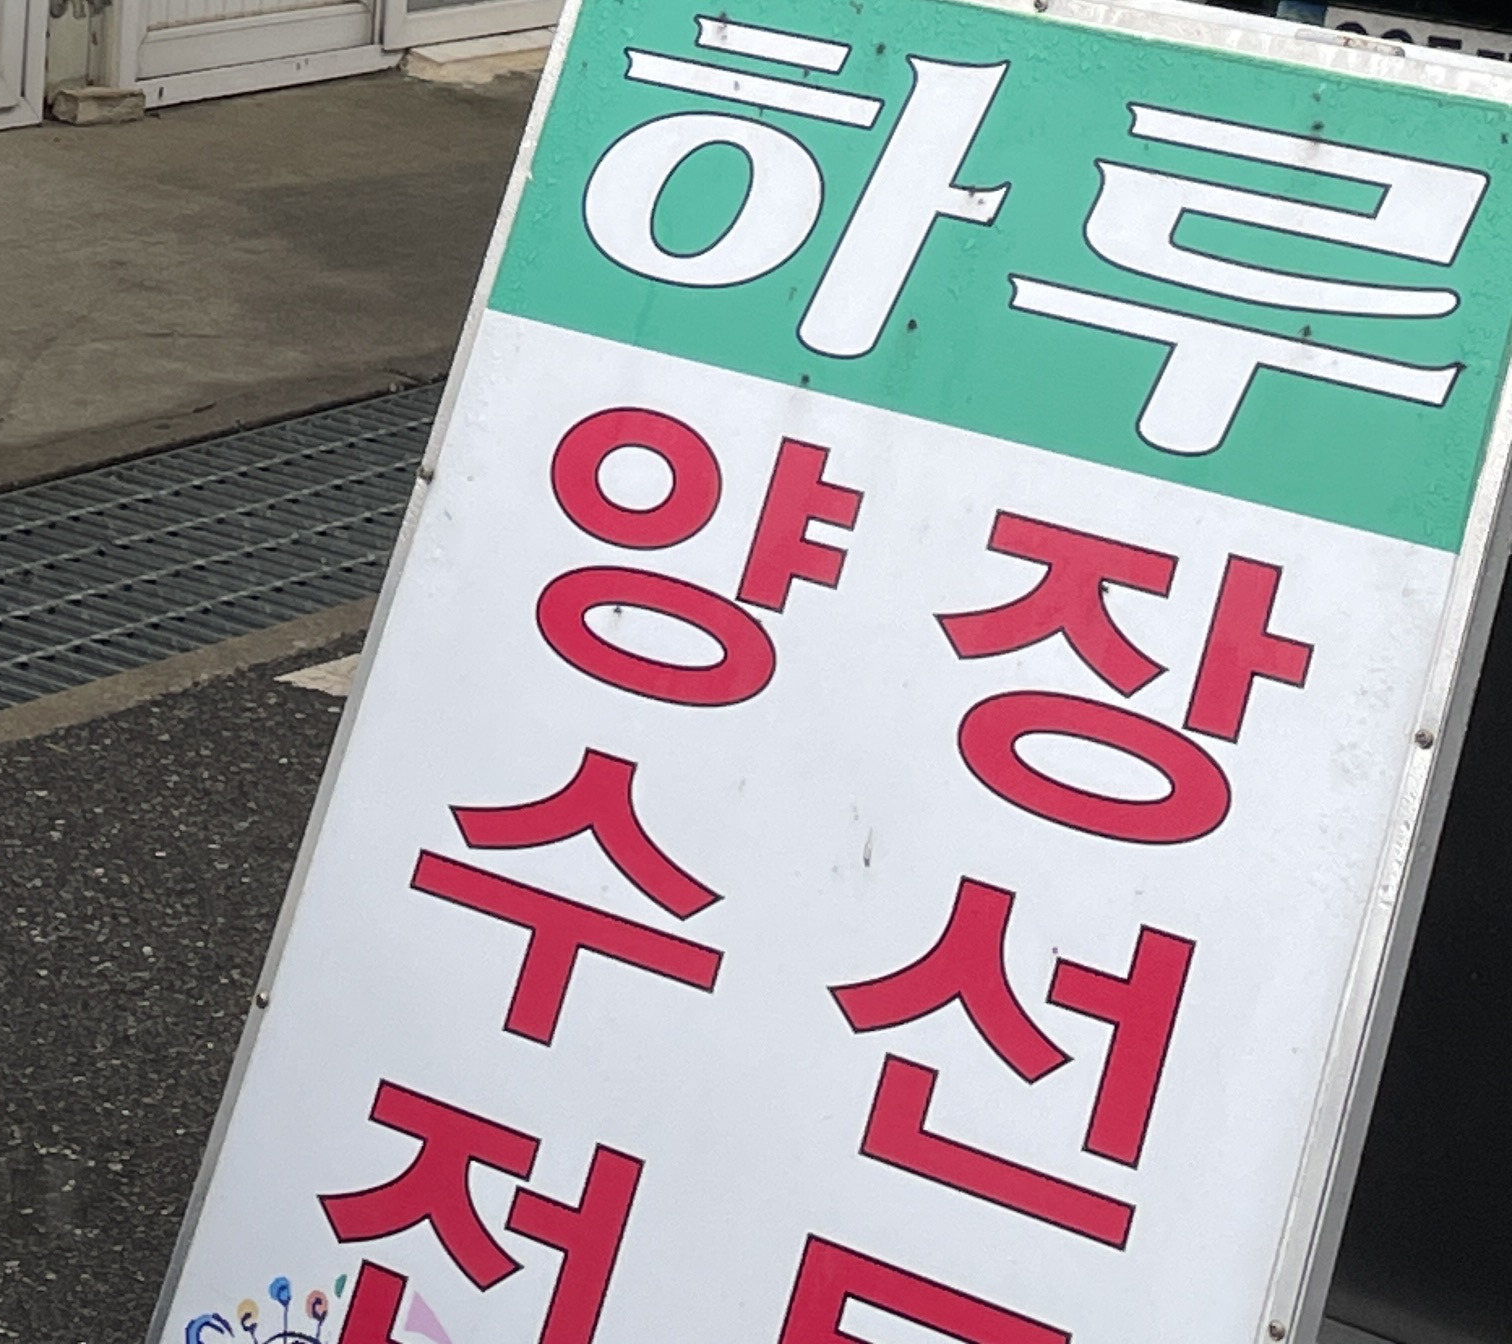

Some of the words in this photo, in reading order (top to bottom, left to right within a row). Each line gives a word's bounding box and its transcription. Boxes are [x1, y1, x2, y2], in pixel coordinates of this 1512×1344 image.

[582, 14, 1490, 457] 하루
[535, 406, 1314, 845] 양장
[410, 748, 1197, 1251] 수선
